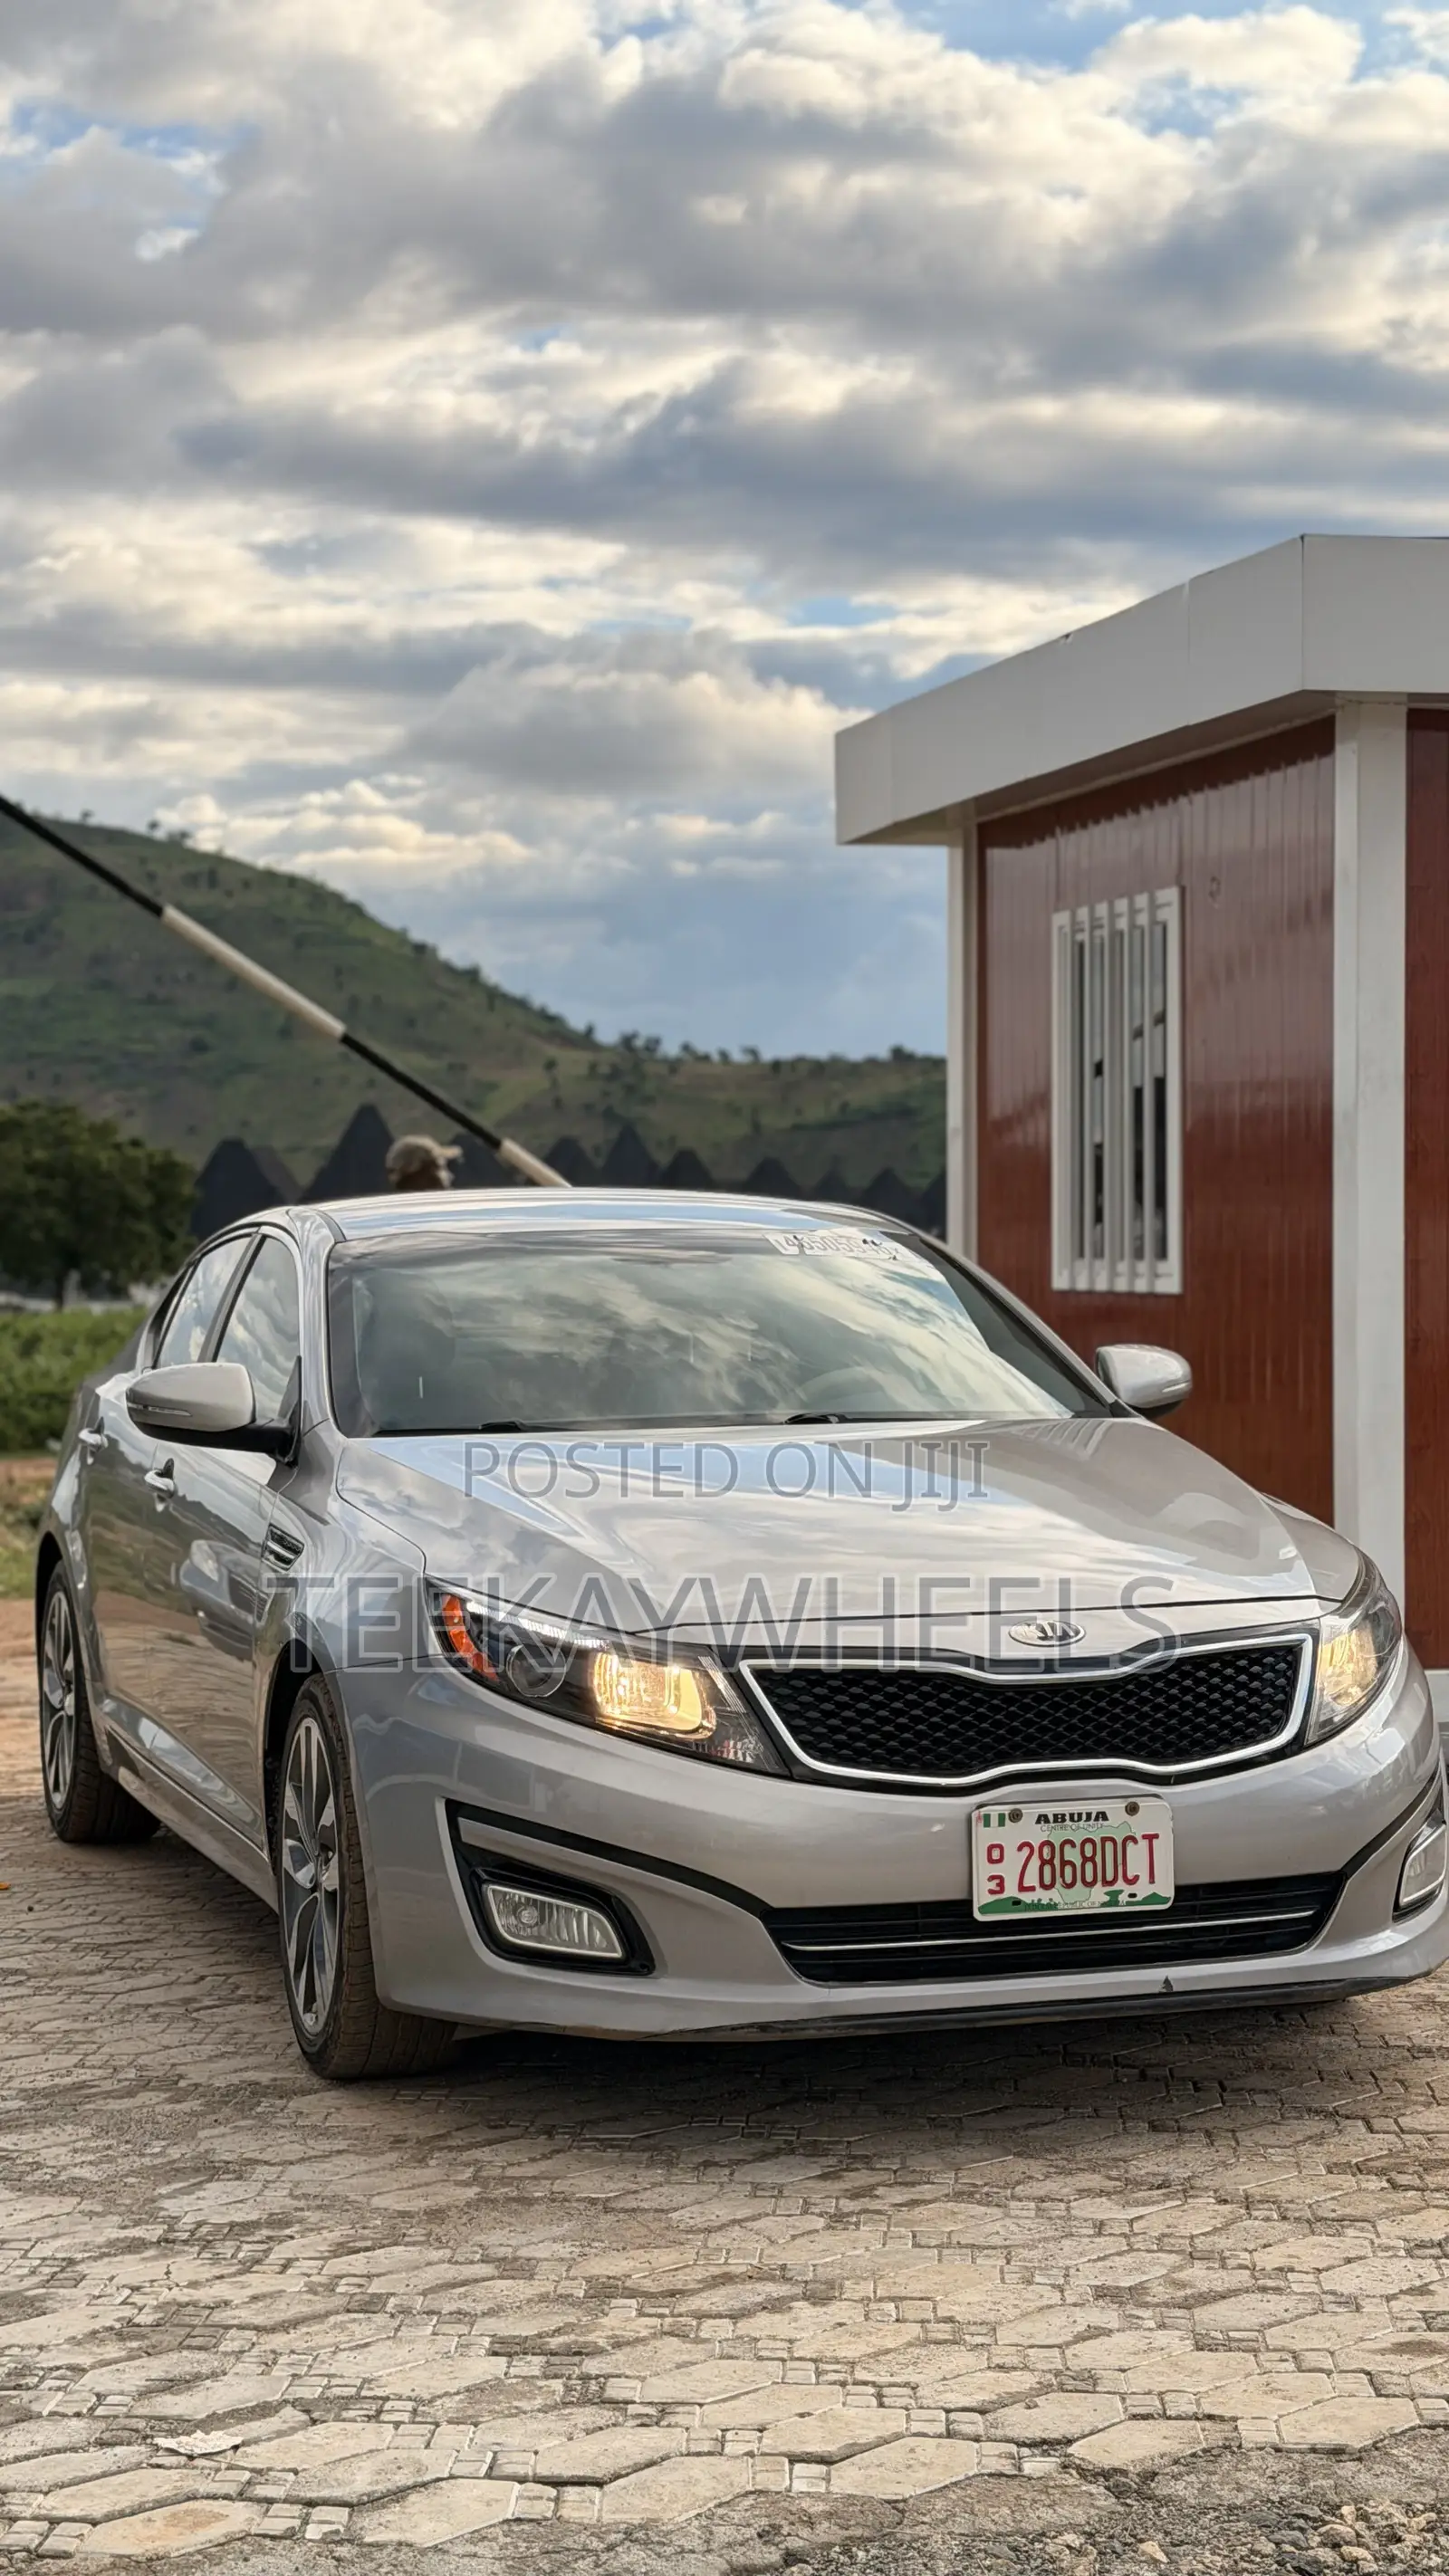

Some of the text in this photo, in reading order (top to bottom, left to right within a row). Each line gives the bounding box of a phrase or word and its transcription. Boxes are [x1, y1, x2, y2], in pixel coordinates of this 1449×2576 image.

[1018, 1621, 1075, 1637] KIA
[1034, 1811, 1109, 1824] ABUJA
[1040, 1824, 1069, 1833] CENTRE
[1016, 1833, 1160, 1893] 2868DCT
